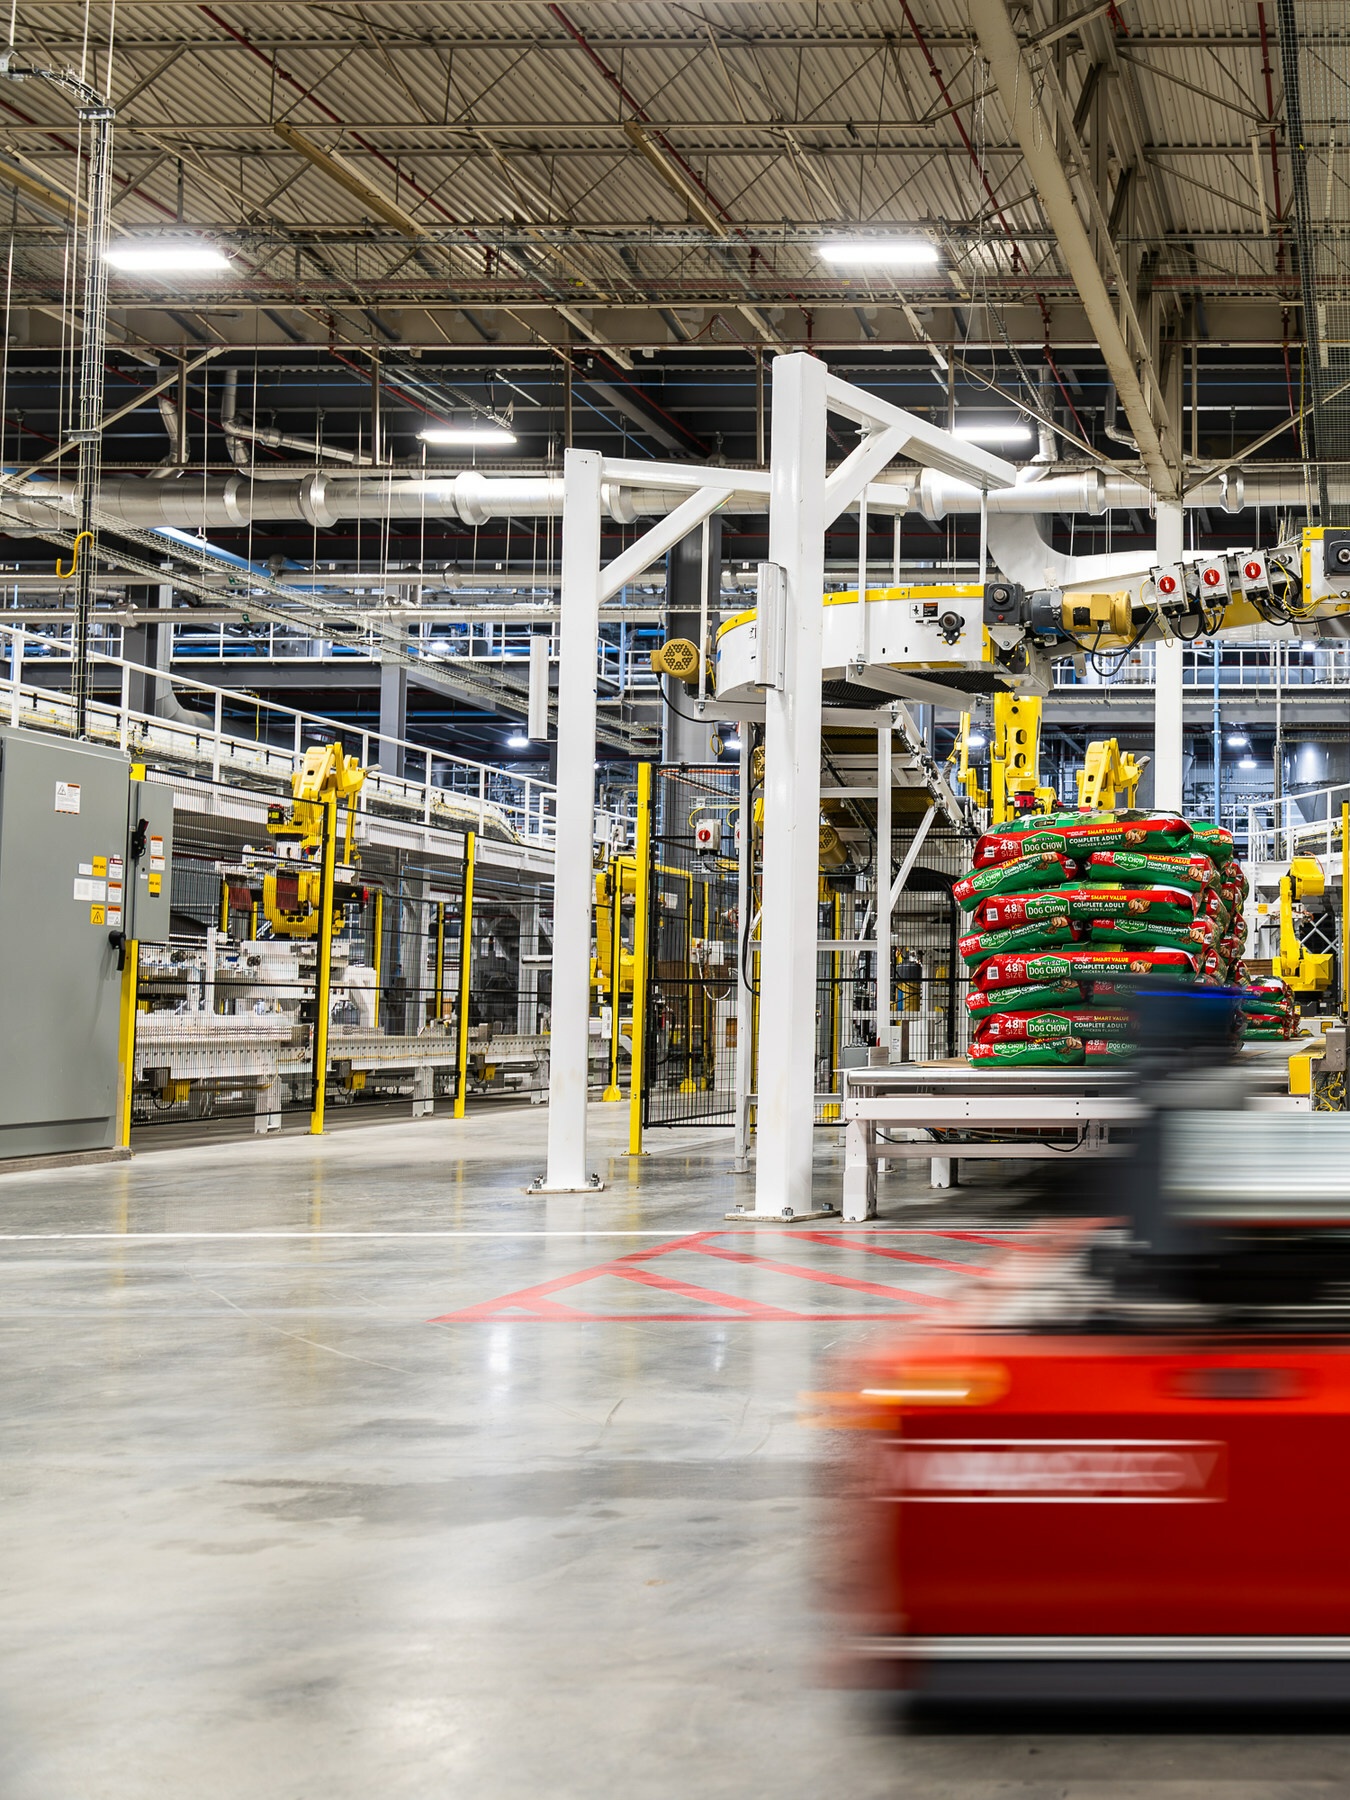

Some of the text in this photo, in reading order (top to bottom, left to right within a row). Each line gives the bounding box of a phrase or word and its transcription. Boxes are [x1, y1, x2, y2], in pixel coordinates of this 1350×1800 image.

[1069, 836, 1100, 844] COMPLETE
[1000, 841, 1013, 850] 48
[1024, 841, 1063, 852] DOG CHOW
[1001, 849, 1018, 857] SIZE
[1128, 856, 1144, 864] CHOW
[974, 878, 985, 887] DOG
[986, 872, 1001, 882] CHOW
[1004, 904, 1017, 913] 48
[1028, 906, 1043, 915] DOG
[1044, 905, 1066, 913] CHOW
[1148, 924, 1171, 932] COMPLETE
[981, 936, 992, 945] DOG
[993, 931, 1009, 941] CHOW
[960, 939, 972, 948] 48
[1005, 963, 1018, 973] 48
[1029, 966, 1068, 975] DOG CHOW
[1005, 1020, 1018, 1029] 48
[1029, 1024, 1068, 1032] DOG CHOW
